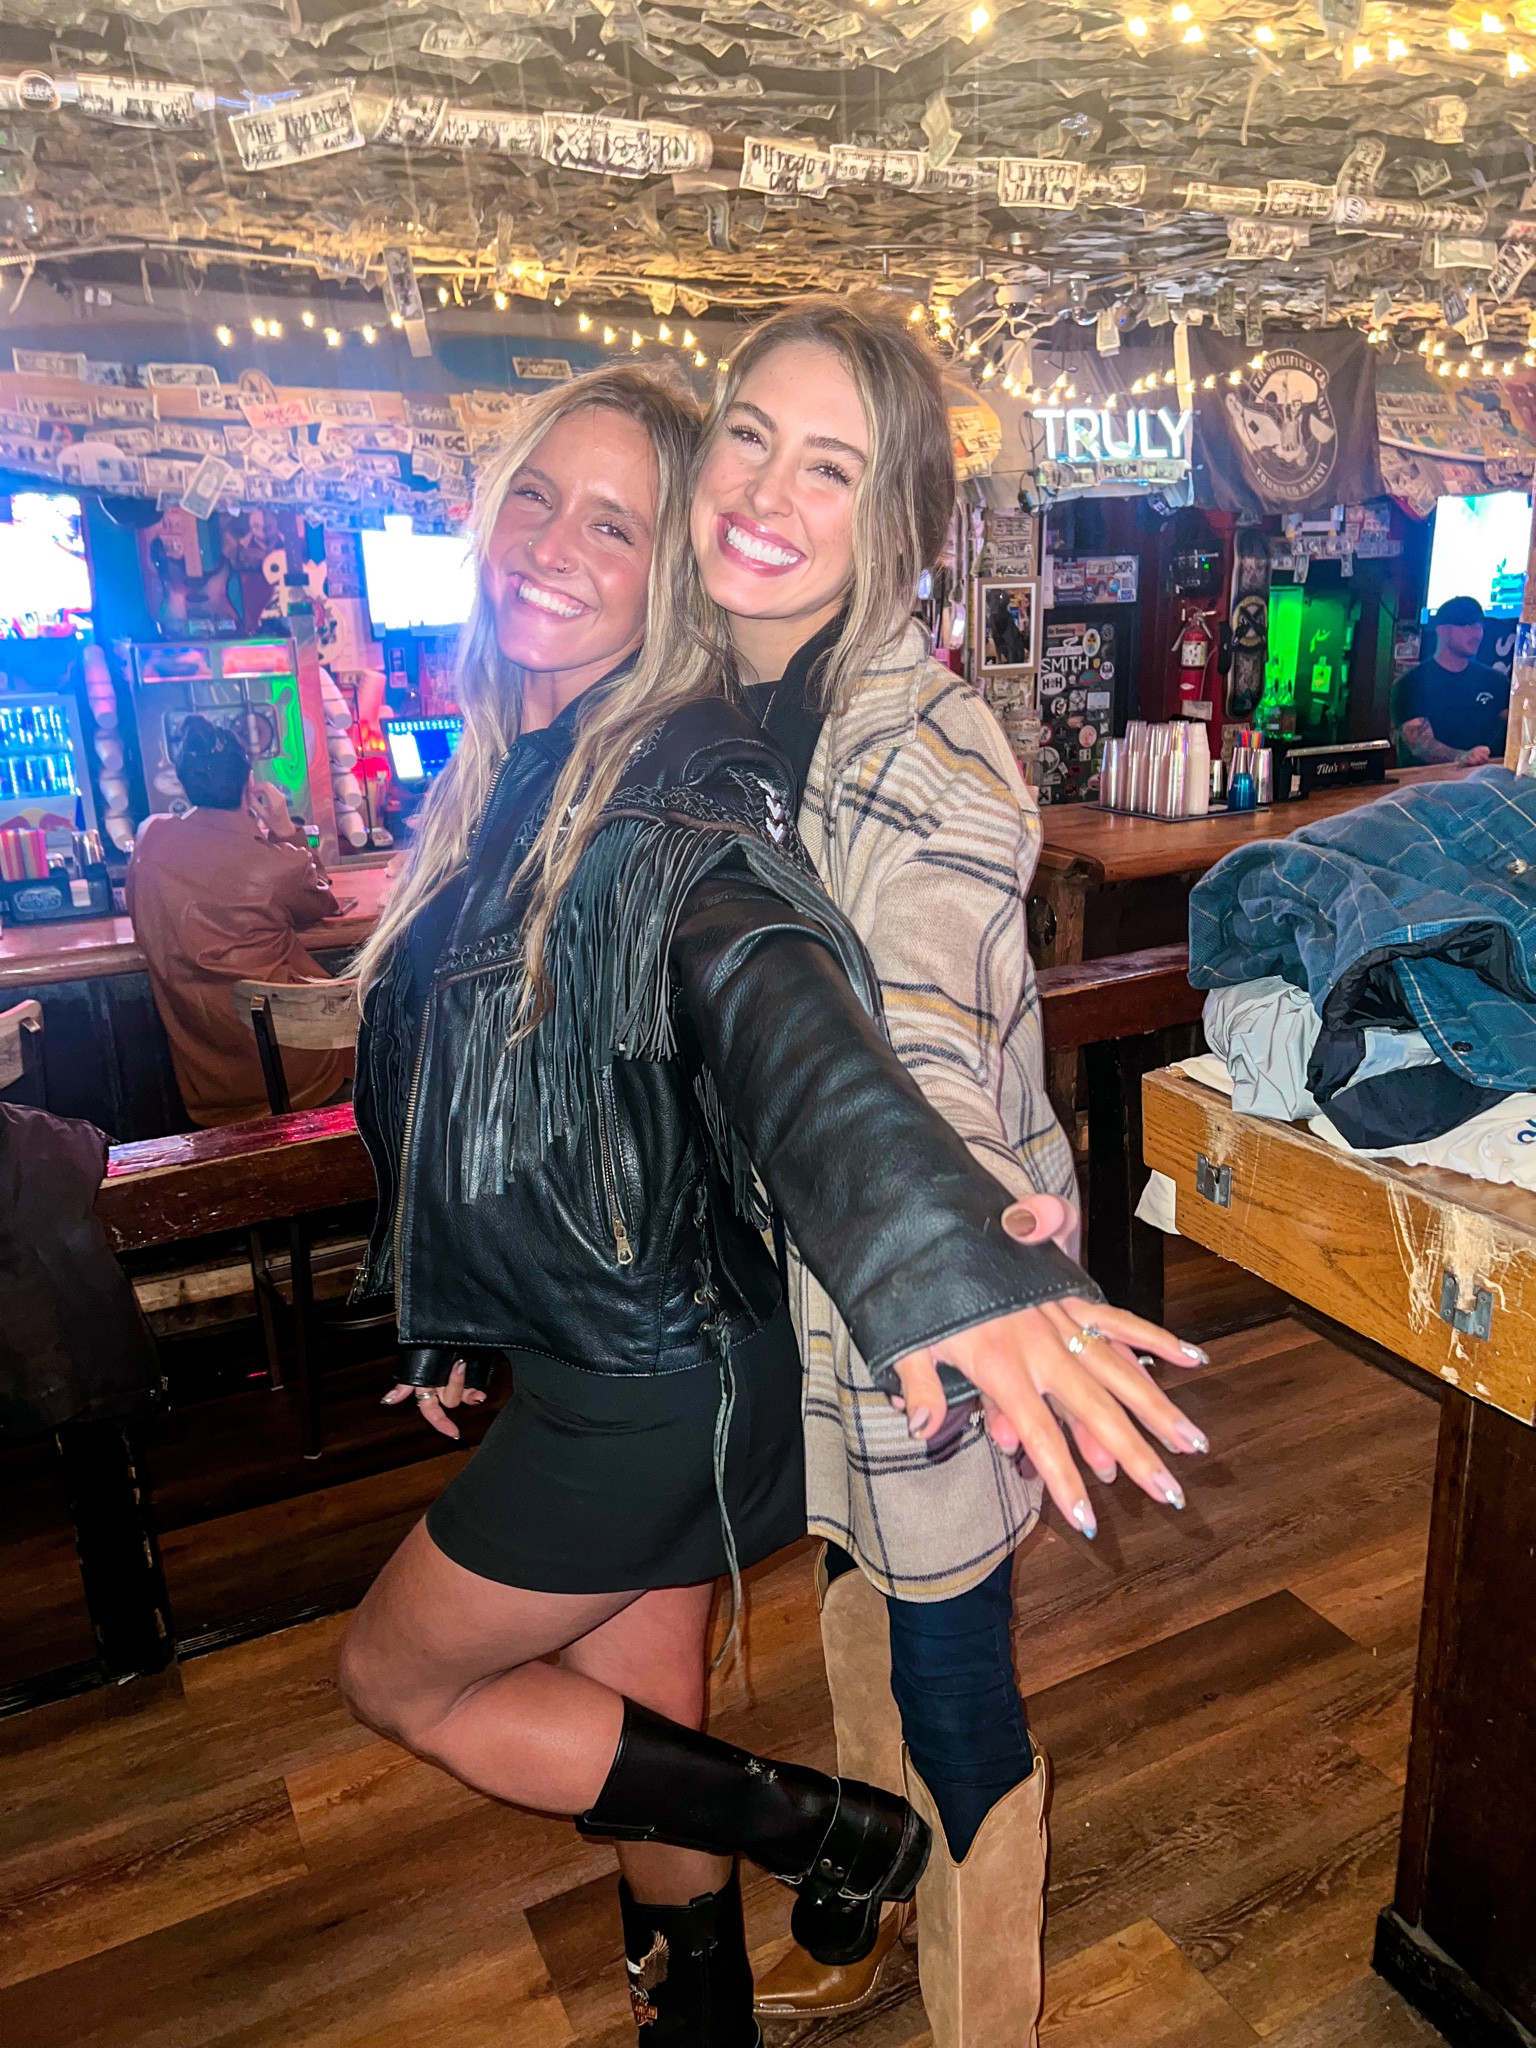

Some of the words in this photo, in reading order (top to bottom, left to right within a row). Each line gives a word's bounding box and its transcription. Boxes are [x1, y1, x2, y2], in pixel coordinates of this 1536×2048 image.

[1265, 354, 1313, 373] QUALIFIED
[1031, 406, 1191, 460] TRULY
[1040, 654, 1089, 674] SMITH
